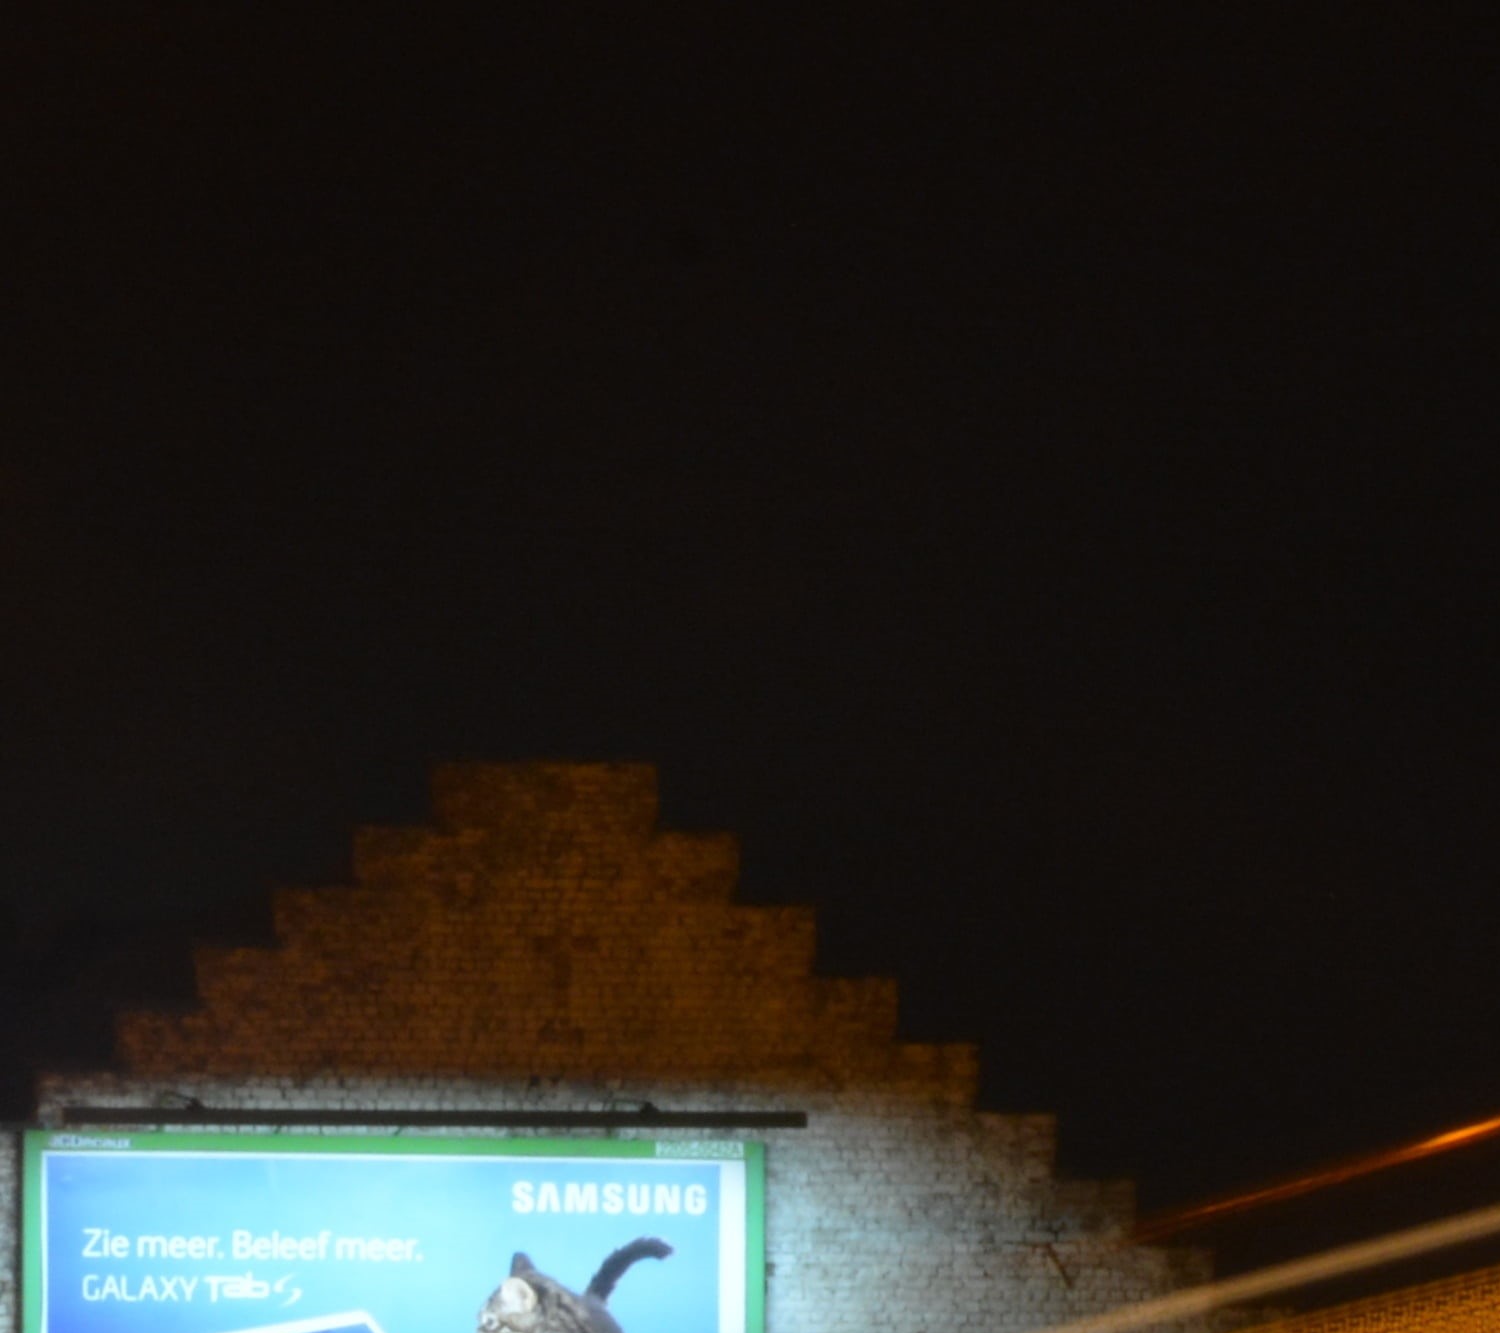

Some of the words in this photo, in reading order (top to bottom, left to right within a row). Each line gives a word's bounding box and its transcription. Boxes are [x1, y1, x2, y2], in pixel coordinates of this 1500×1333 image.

[513, 1181, 708, 1214] SAMSUNG
[83, 1227, 130, 1259] Zie
[136, 1235, 225, 1260] meer.
[231, 1229, 331, 1261] Beleef
[334, 1239, 425, 1263] meer.
[82, 1274, 198, 1302] GALAXY
[203, 1271, 270, 1303] Tab
